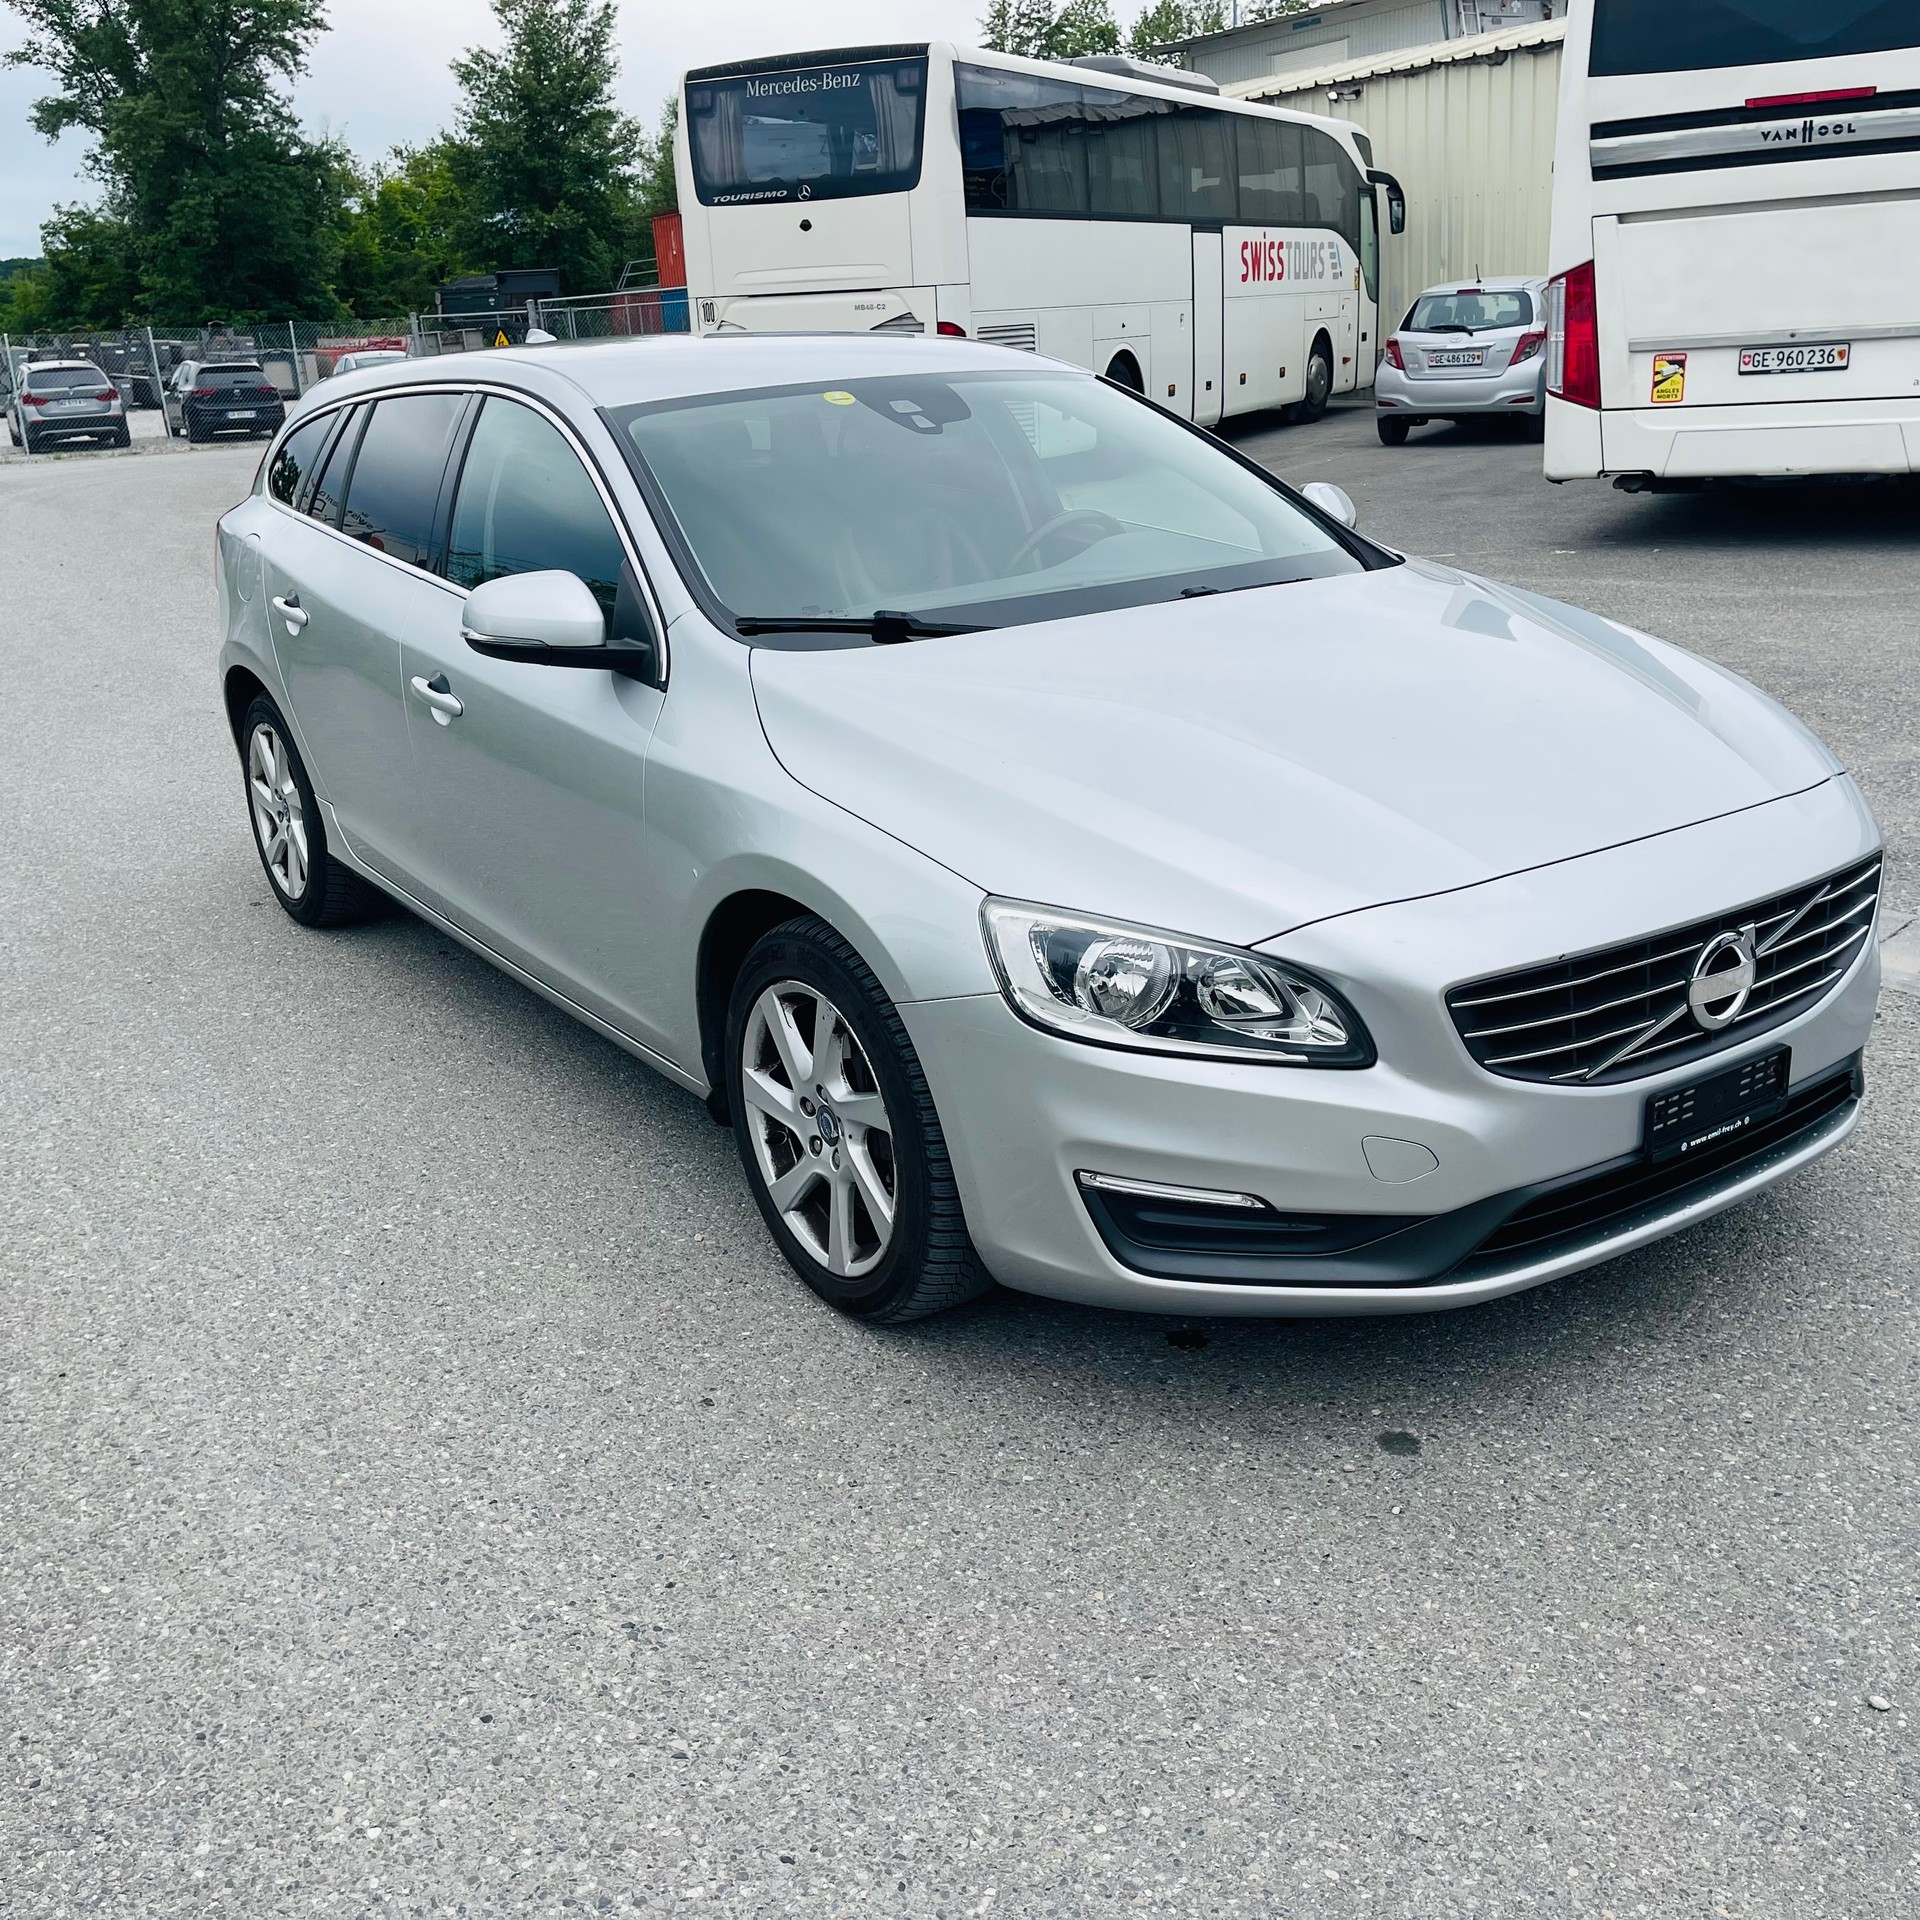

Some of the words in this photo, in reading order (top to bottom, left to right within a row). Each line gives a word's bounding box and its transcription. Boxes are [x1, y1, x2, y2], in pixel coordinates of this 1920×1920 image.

[746, 72, 861, 98] Mercedes-Benz
[712, 190, 788, 204] TOURISMO
[701, 302, 715, 322] 100
[854, 303, 886, 311] MB48-C2
[1690, 1119, 1742, 1146] www.emil-frey.ch
